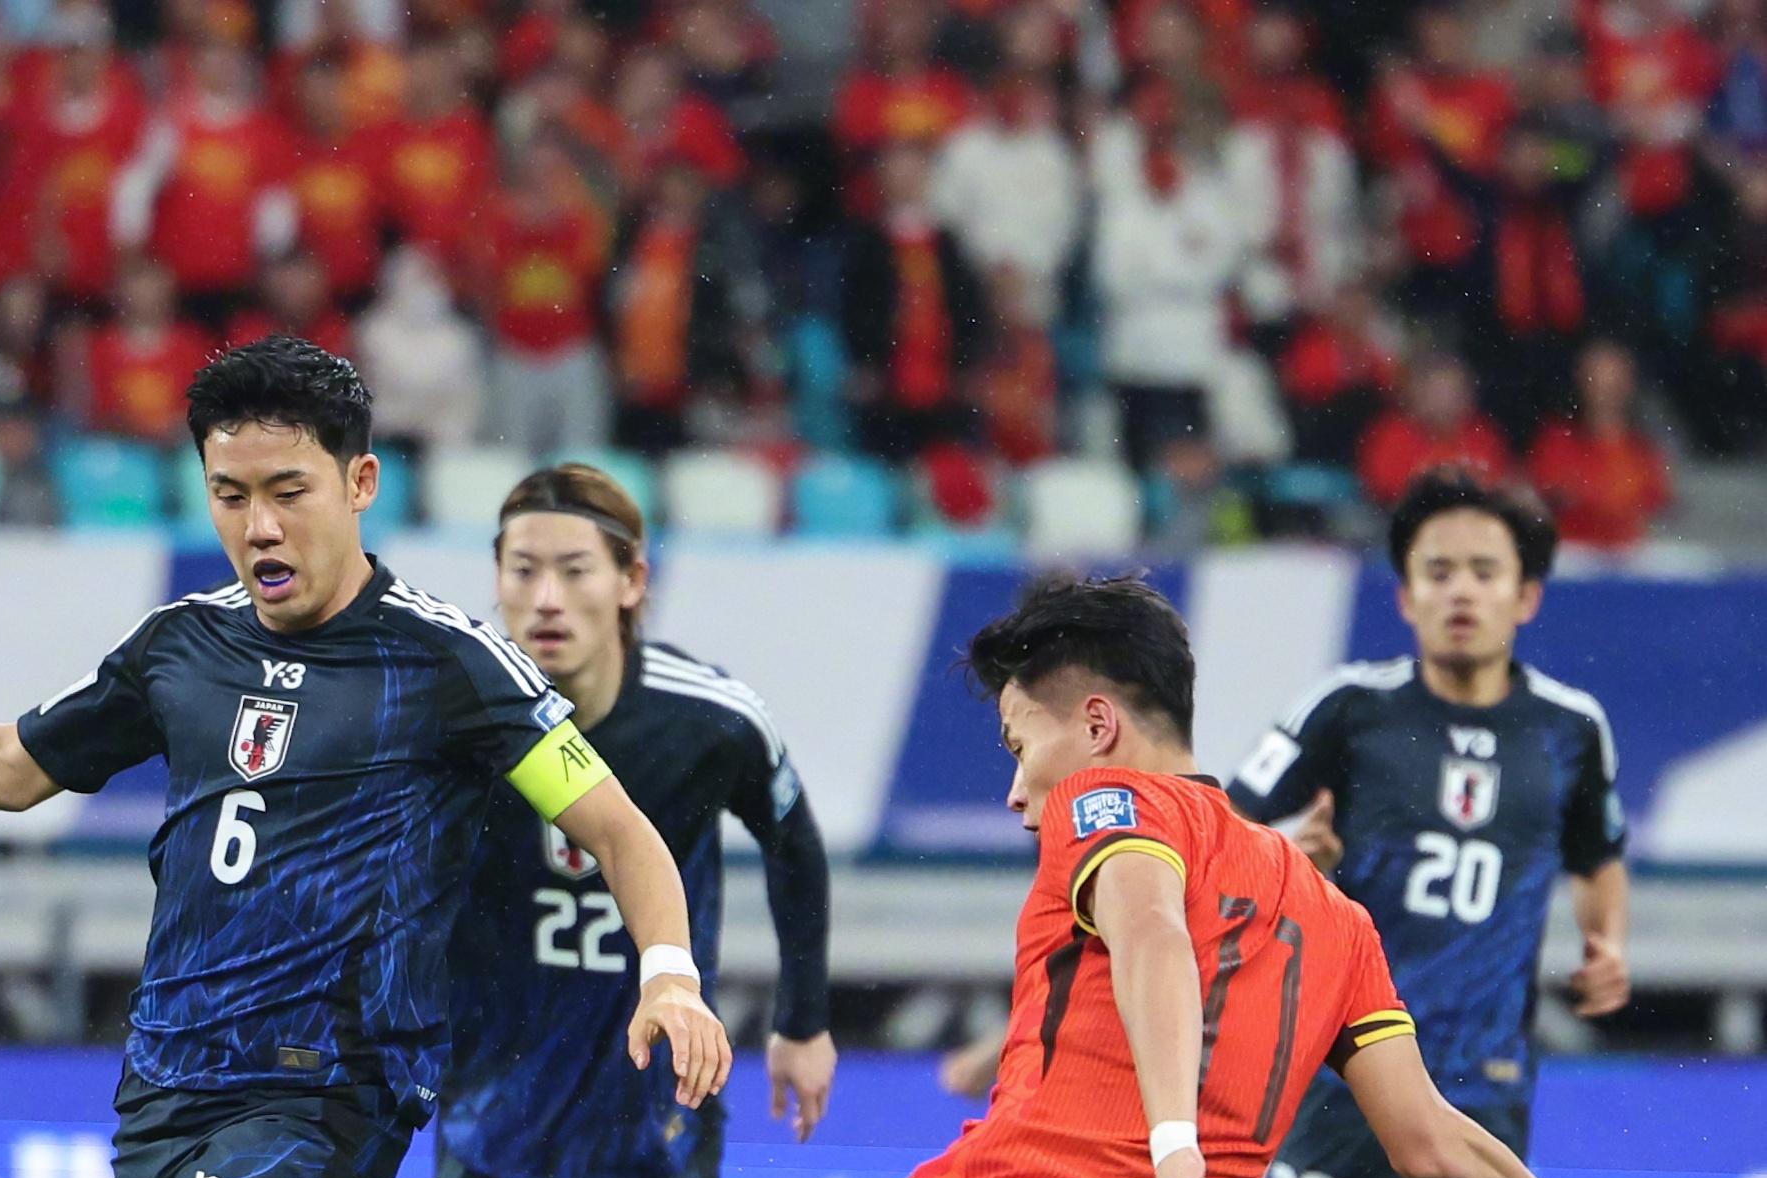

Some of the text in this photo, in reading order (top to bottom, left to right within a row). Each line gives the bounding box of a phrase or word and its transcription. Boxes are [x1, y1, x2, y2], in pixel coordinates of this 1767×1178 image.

[254, 700, 285, 713] JAPAN
[261, 659, 307, 690] Y-3
[559, 734, 595, 783] AF
[211, 788, 266, 885] 6
[1402, 830, 1504, 924] 20
[533, 887, 627, 973] 22
